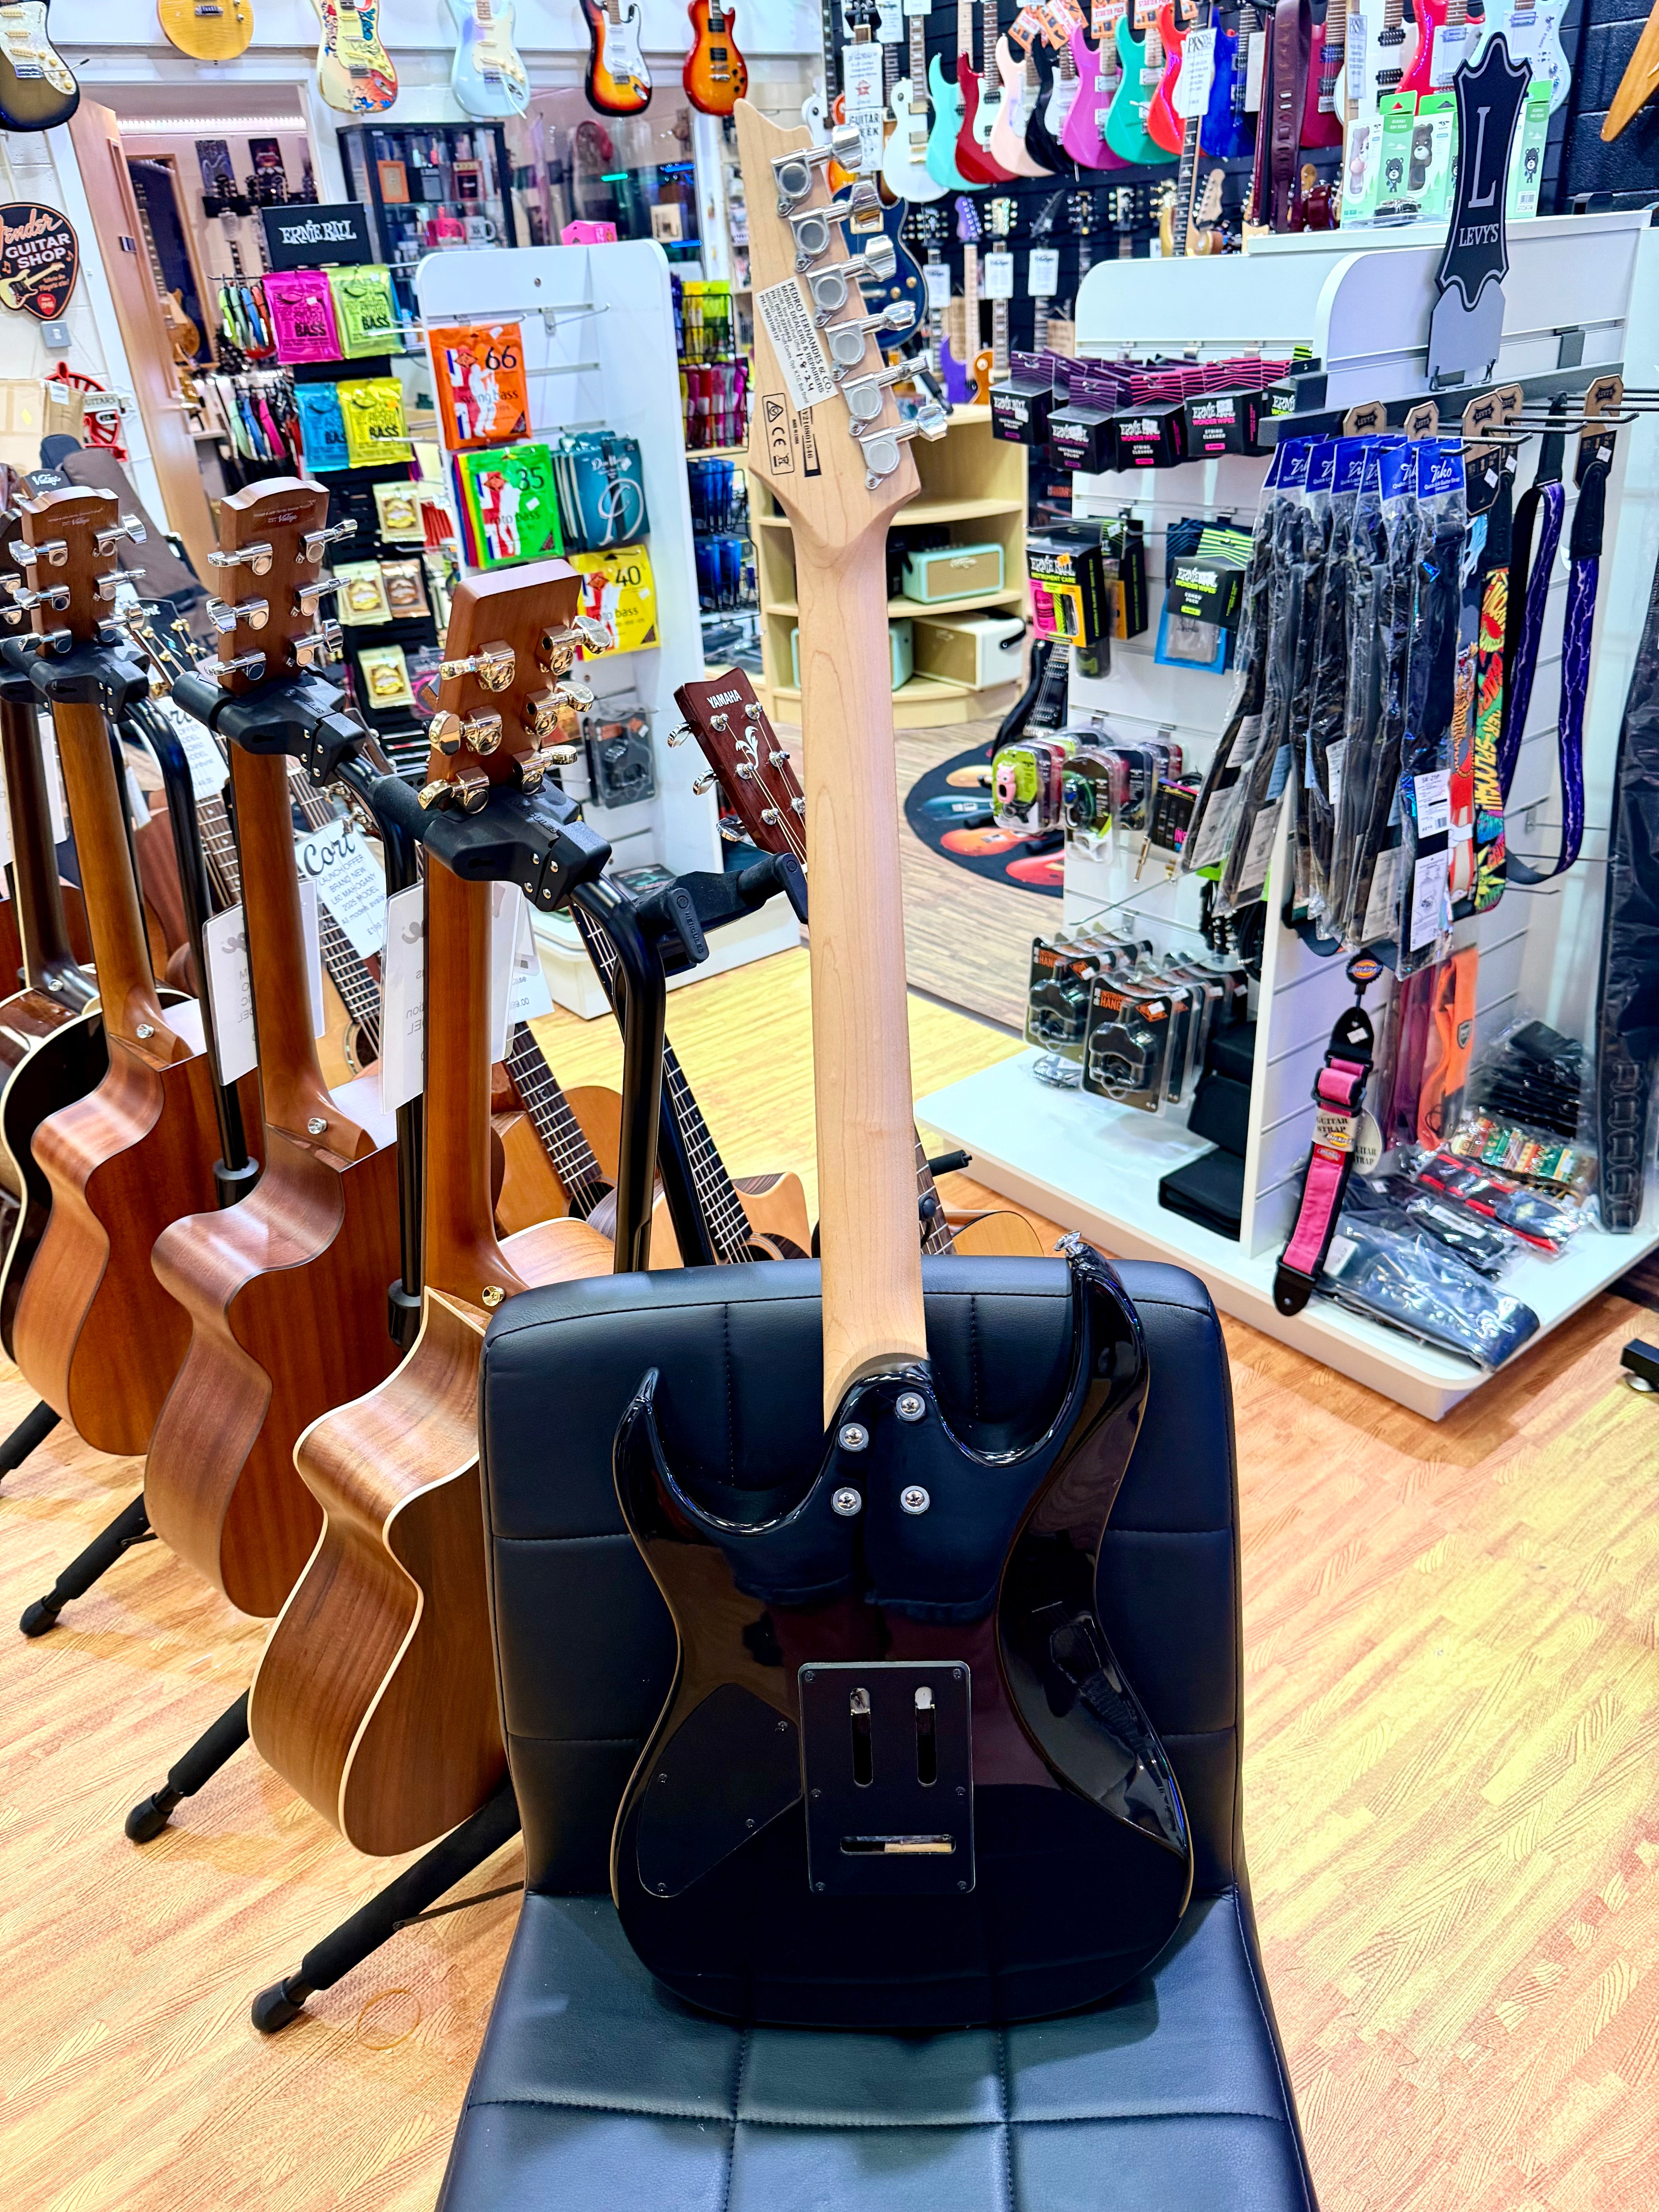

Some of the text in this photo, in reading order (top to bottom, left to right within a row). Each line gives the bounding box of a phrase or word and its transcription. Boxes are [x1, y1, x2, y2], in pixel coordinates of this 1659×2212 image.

[857, 127, 879, 136] EEK
[1468, 106, 1496, 208] L
[278, 220, 357, 244] ERNIE BALL
[1459, 224, 1499, 247] LEVY'S
[5, 233, 71, 259] GUITAR
[17, 247, 67, 269] SHOP
[294, 322, 326, 337] BASS
[361, 315, 391, 330] BASS
[786, 281, 804, 313] PEDRO
[797, 313, 825, 365] FERNANDES
[779, 285, 794, 310] MUSIC
[788, 310, 807, 345] DEALERS
[804, 352, 826, 393] REPAIRERS
[486, 345, 517, 370] 66
[1192, 402, 1216, 419] ERNIE
[1475, 407, 1492, 419] LEVY'S
[325, 431, 347, 444] BAS
[802, 408, 813, 459] Y210801546
[31, 474, 62, 486] Vintage
[516, 466, 544, 491] 35
[1431, 460, 1452, 483] Tiko
[1029, 555, 1054, 572] ERNIE
[616, 566, 641, 587] 40
[615, 607, 639, 618] bass
[707, 689, 742, 709] YAMAHA
[304, 832, 356, 876] Cort
[318, 867, 343, 886] LAUNCH
[329, 866, 367, 893] BRAND NEW
[342, 872, 377, 896] MAHOGANY
[356, 884, 380, 900] MODEL
[1100, 996, 1122, 1012] HANG
[1355, 1156, 1374, 1165] TRAP
[1356, 1146, 1376, 1155] UITAR
